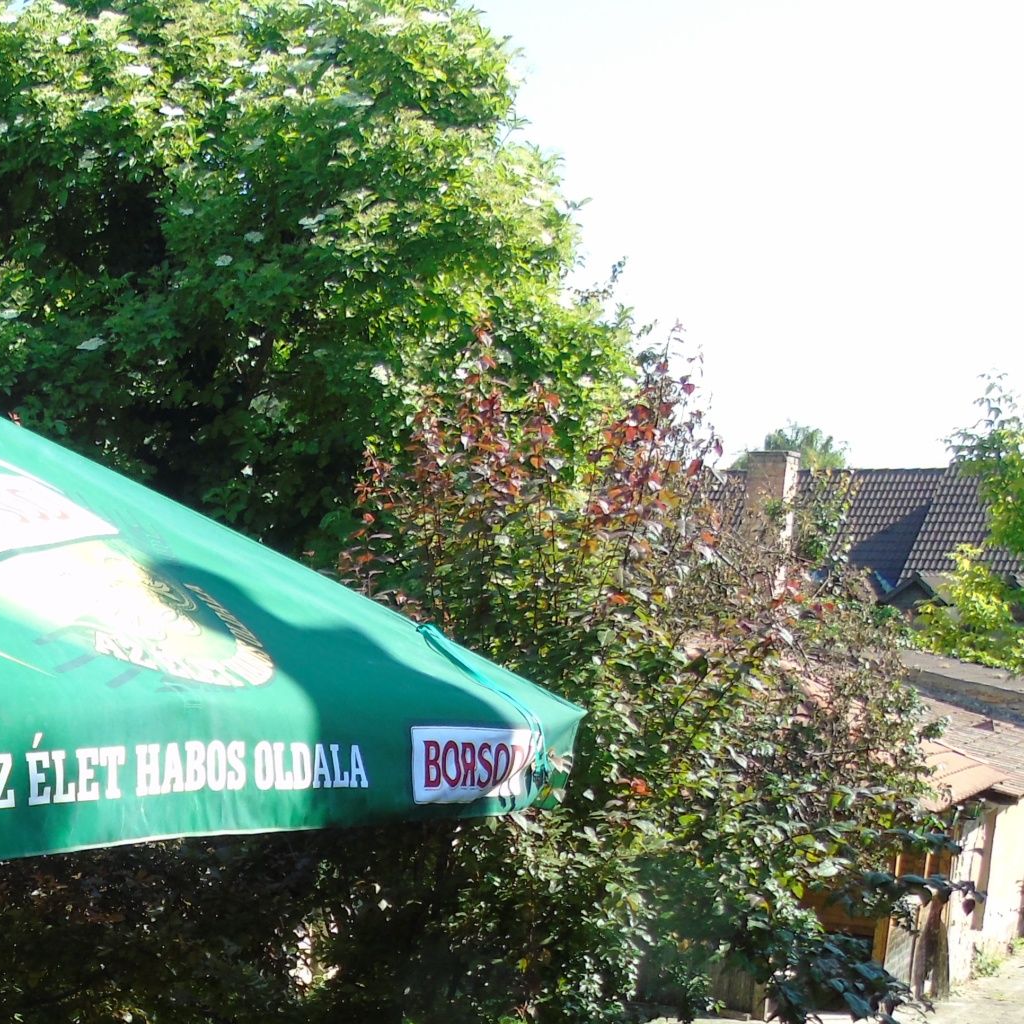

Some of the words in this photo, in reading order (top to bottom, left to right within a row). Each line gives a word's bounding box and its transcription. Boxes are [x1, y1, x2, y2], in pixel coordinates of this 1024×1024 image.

[25, 733, 126, 807] ÉLET
[136, 739, 246, 797] HABOS
[254, 740, 369, 792] OLDALA
[423, 740, 533, 791] BORSOD
